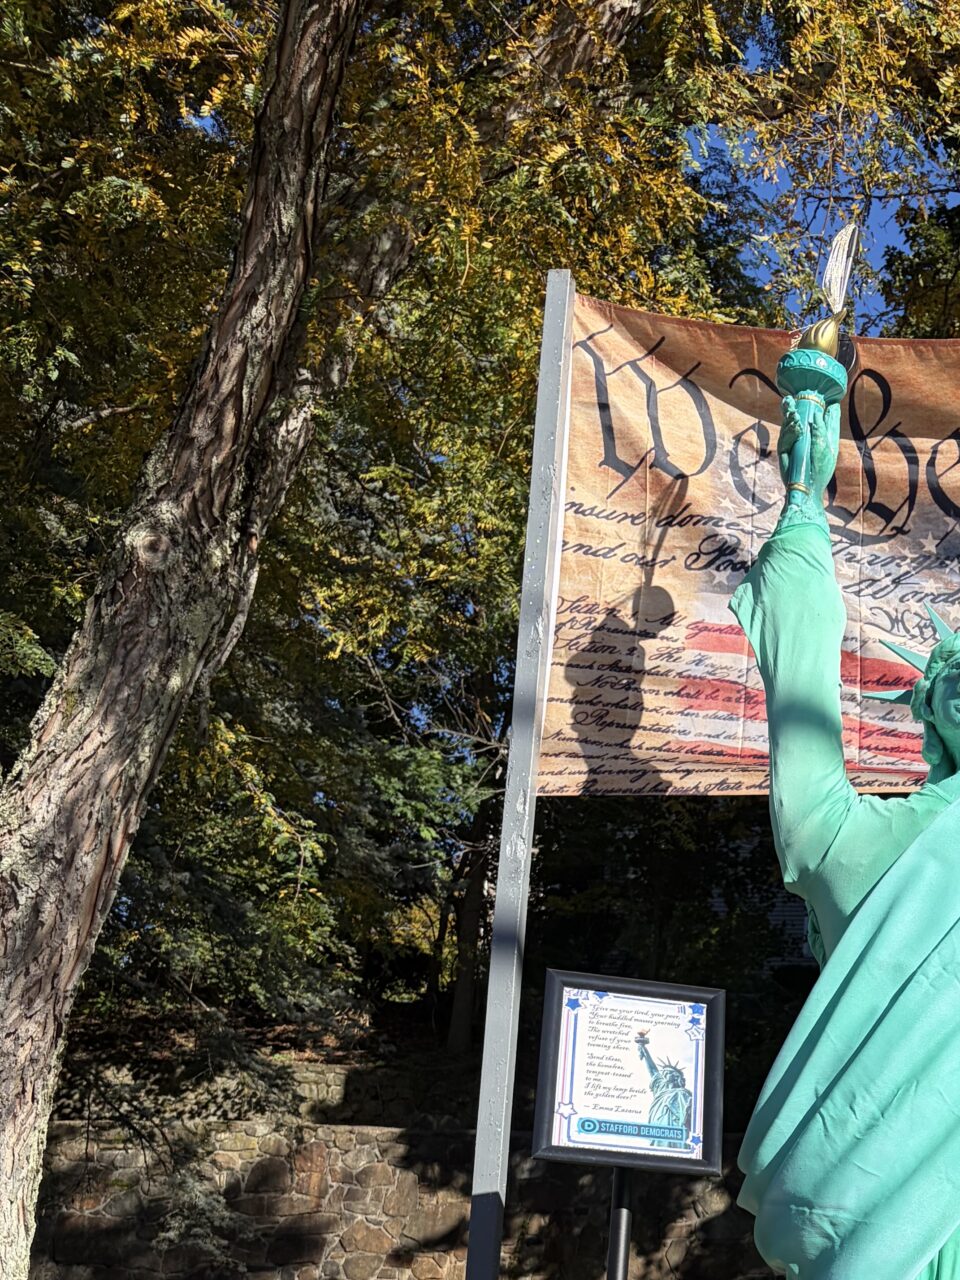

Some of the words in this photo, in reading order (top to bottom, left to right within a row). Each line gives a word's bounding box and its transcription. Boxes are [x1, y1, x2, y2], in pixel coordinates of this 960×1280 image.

[574, 324, 785, 518] We
[608, 1013, 633, 1022] huddled
[653, 1020, 681, 1028] yearning
[602, 1028, 629, 1036] wretched
[613, 1085, 628, 1093] lamp
[592, 1103, 613, 1111] Emma
[614, 1105, 643, 1114] Lazarus
[600, 1123, 638, 1135] STAFFORD
[640, 1126, 682, 1139] DEMOCRATS
